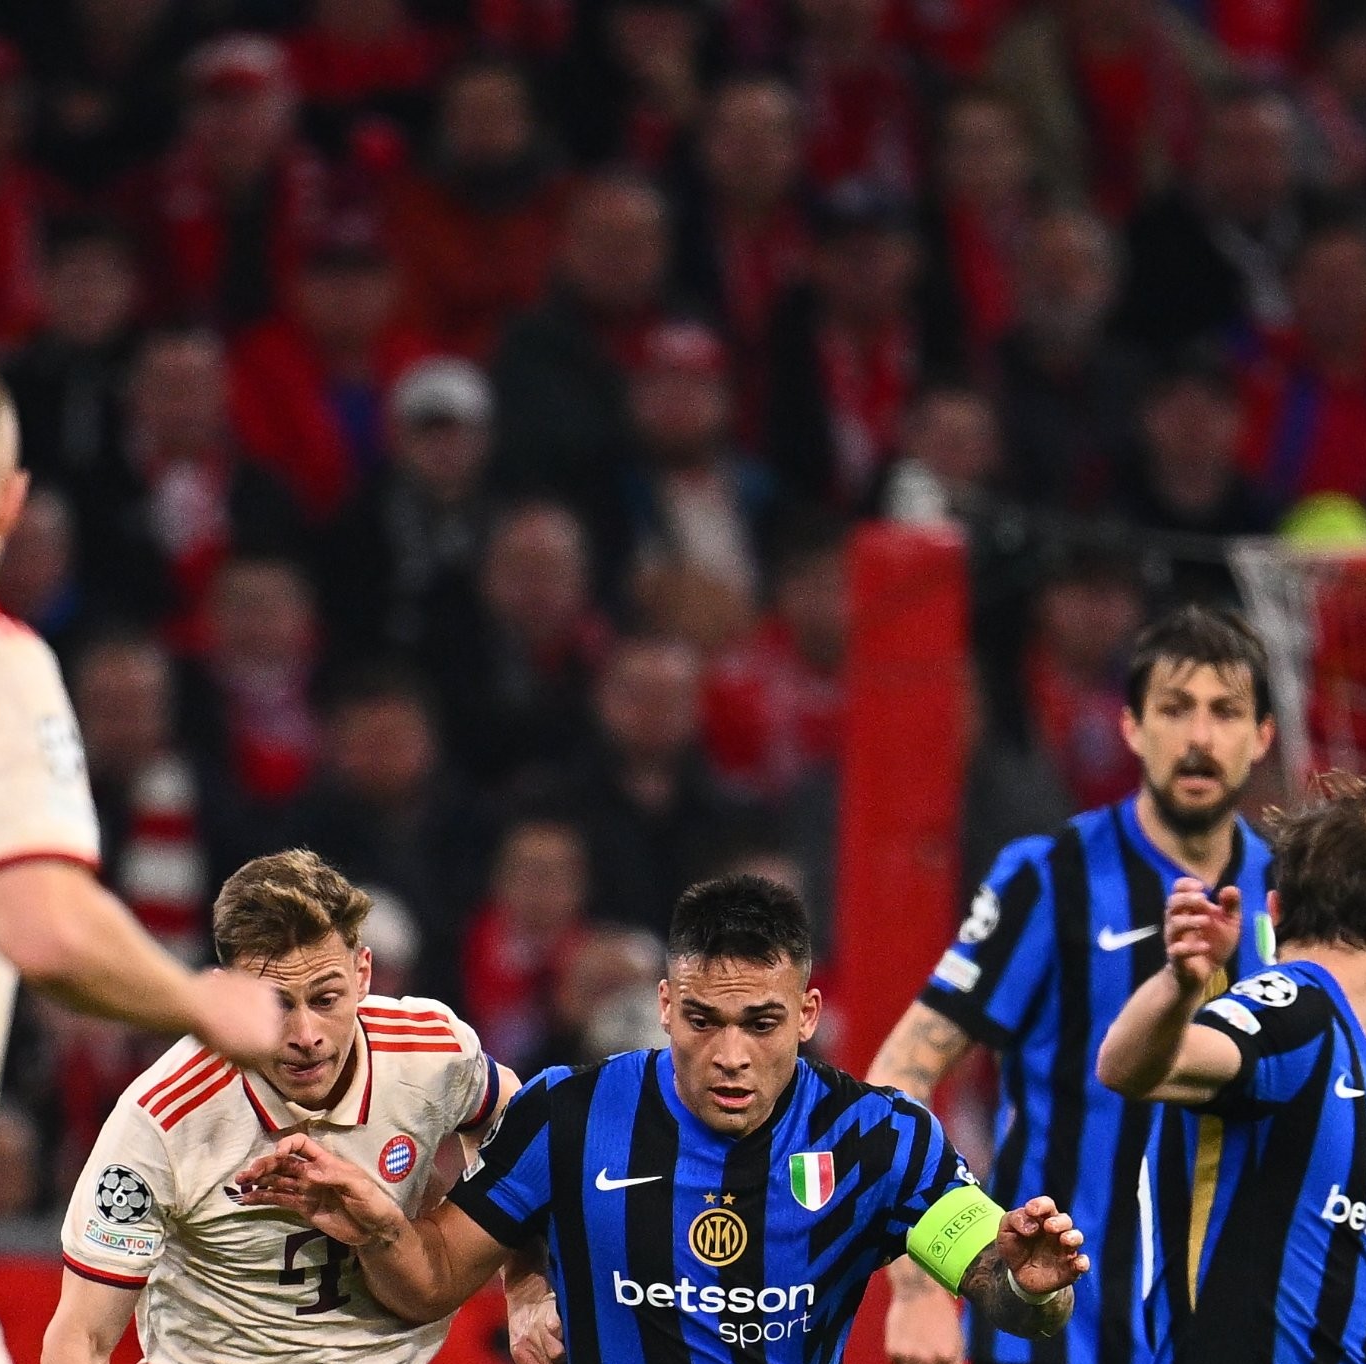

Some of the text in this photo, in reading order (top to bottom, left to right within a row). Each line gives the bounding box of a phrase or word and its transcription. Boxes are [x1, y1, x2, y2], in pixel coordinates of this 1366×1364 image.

[86, 1224, 153, 1250] FOUNDATION
[612, 1270, 815, 1314] betsson
[718, 1311, 812, 1349] sport
